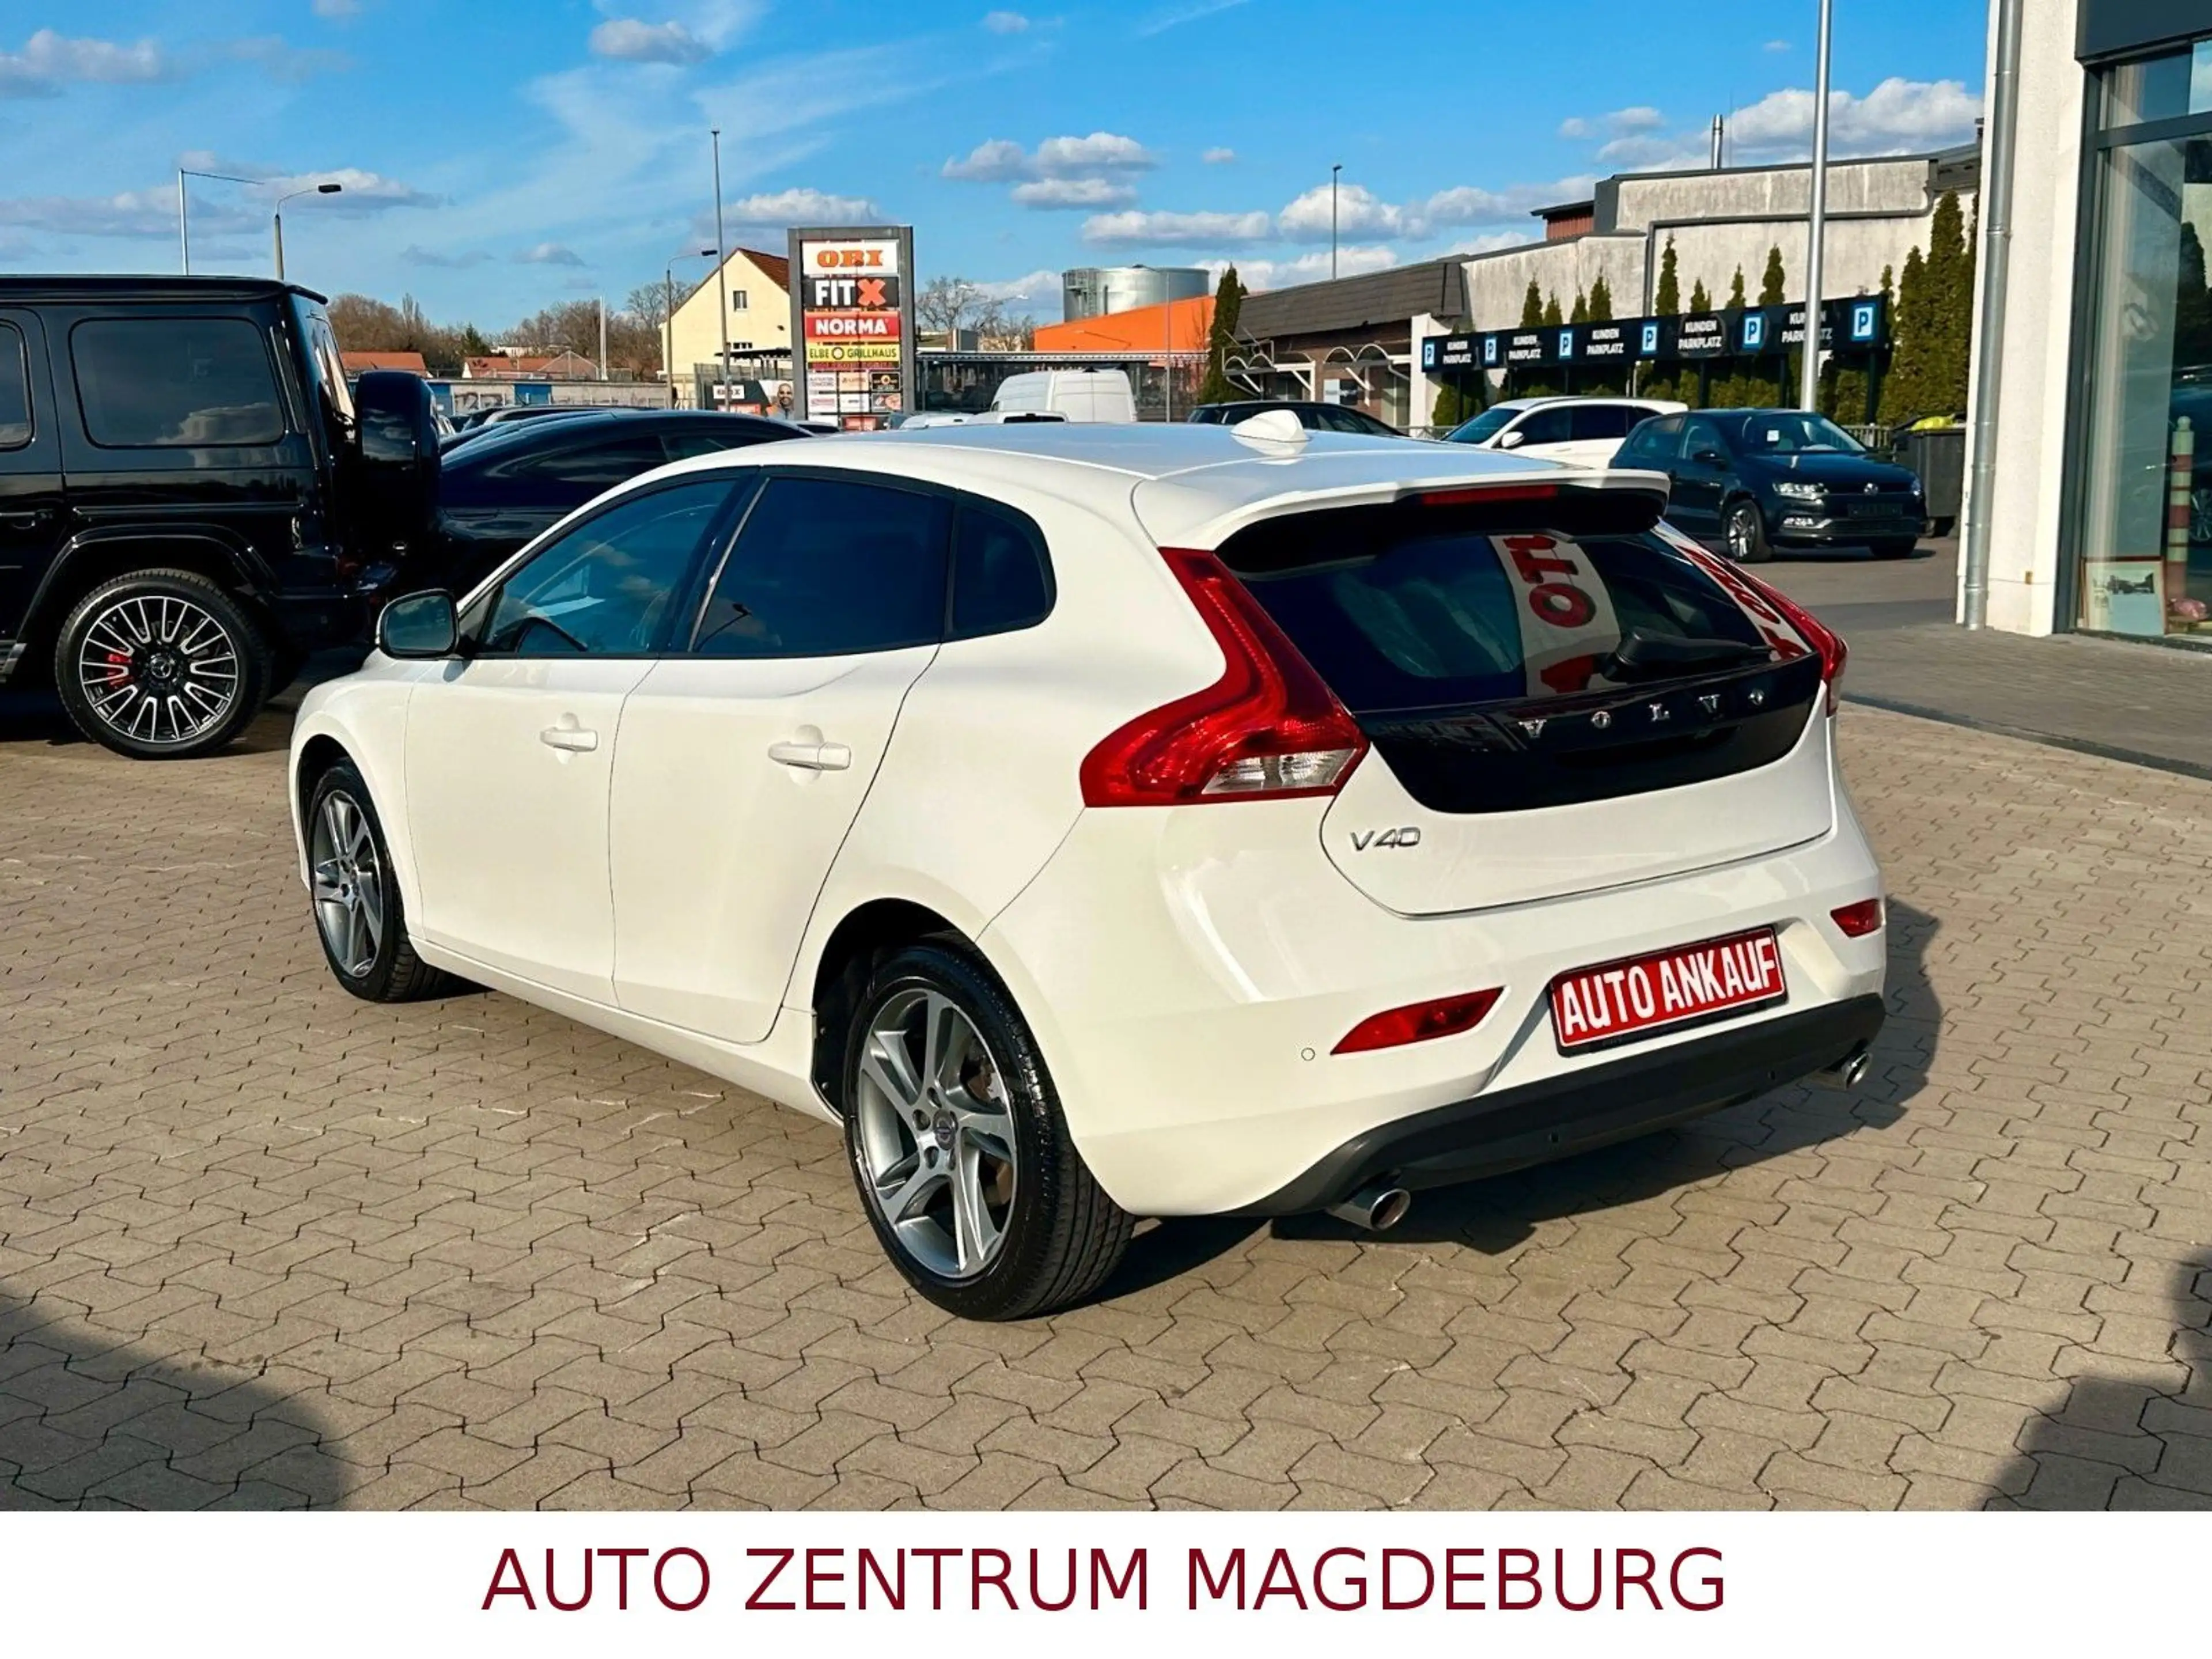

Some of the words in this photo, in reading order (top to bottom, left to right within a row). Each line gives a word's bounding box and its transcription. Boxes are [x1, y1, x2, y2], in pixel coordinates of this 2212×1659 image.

[817, 250, 883, 267] OBI
[815, 279, 886, 306] FITX
[815, 318, 888, 335] NORMA
[1592, 328, 1620, 340] KUNDEN
[1685, 320, 1717, 333] KUNDEN
[1586, 343, 1624, 355] PARKPLATZ
[1678, 336, 1722, 349] PARKPLATZ
[1519, 688, 1765, 739] VOLVO
[1350, 827, 1421, 851] V40
[1561, 965, 1656, 1036] AUTO
[1659, 937, 1776, 1013] ANKAUF
